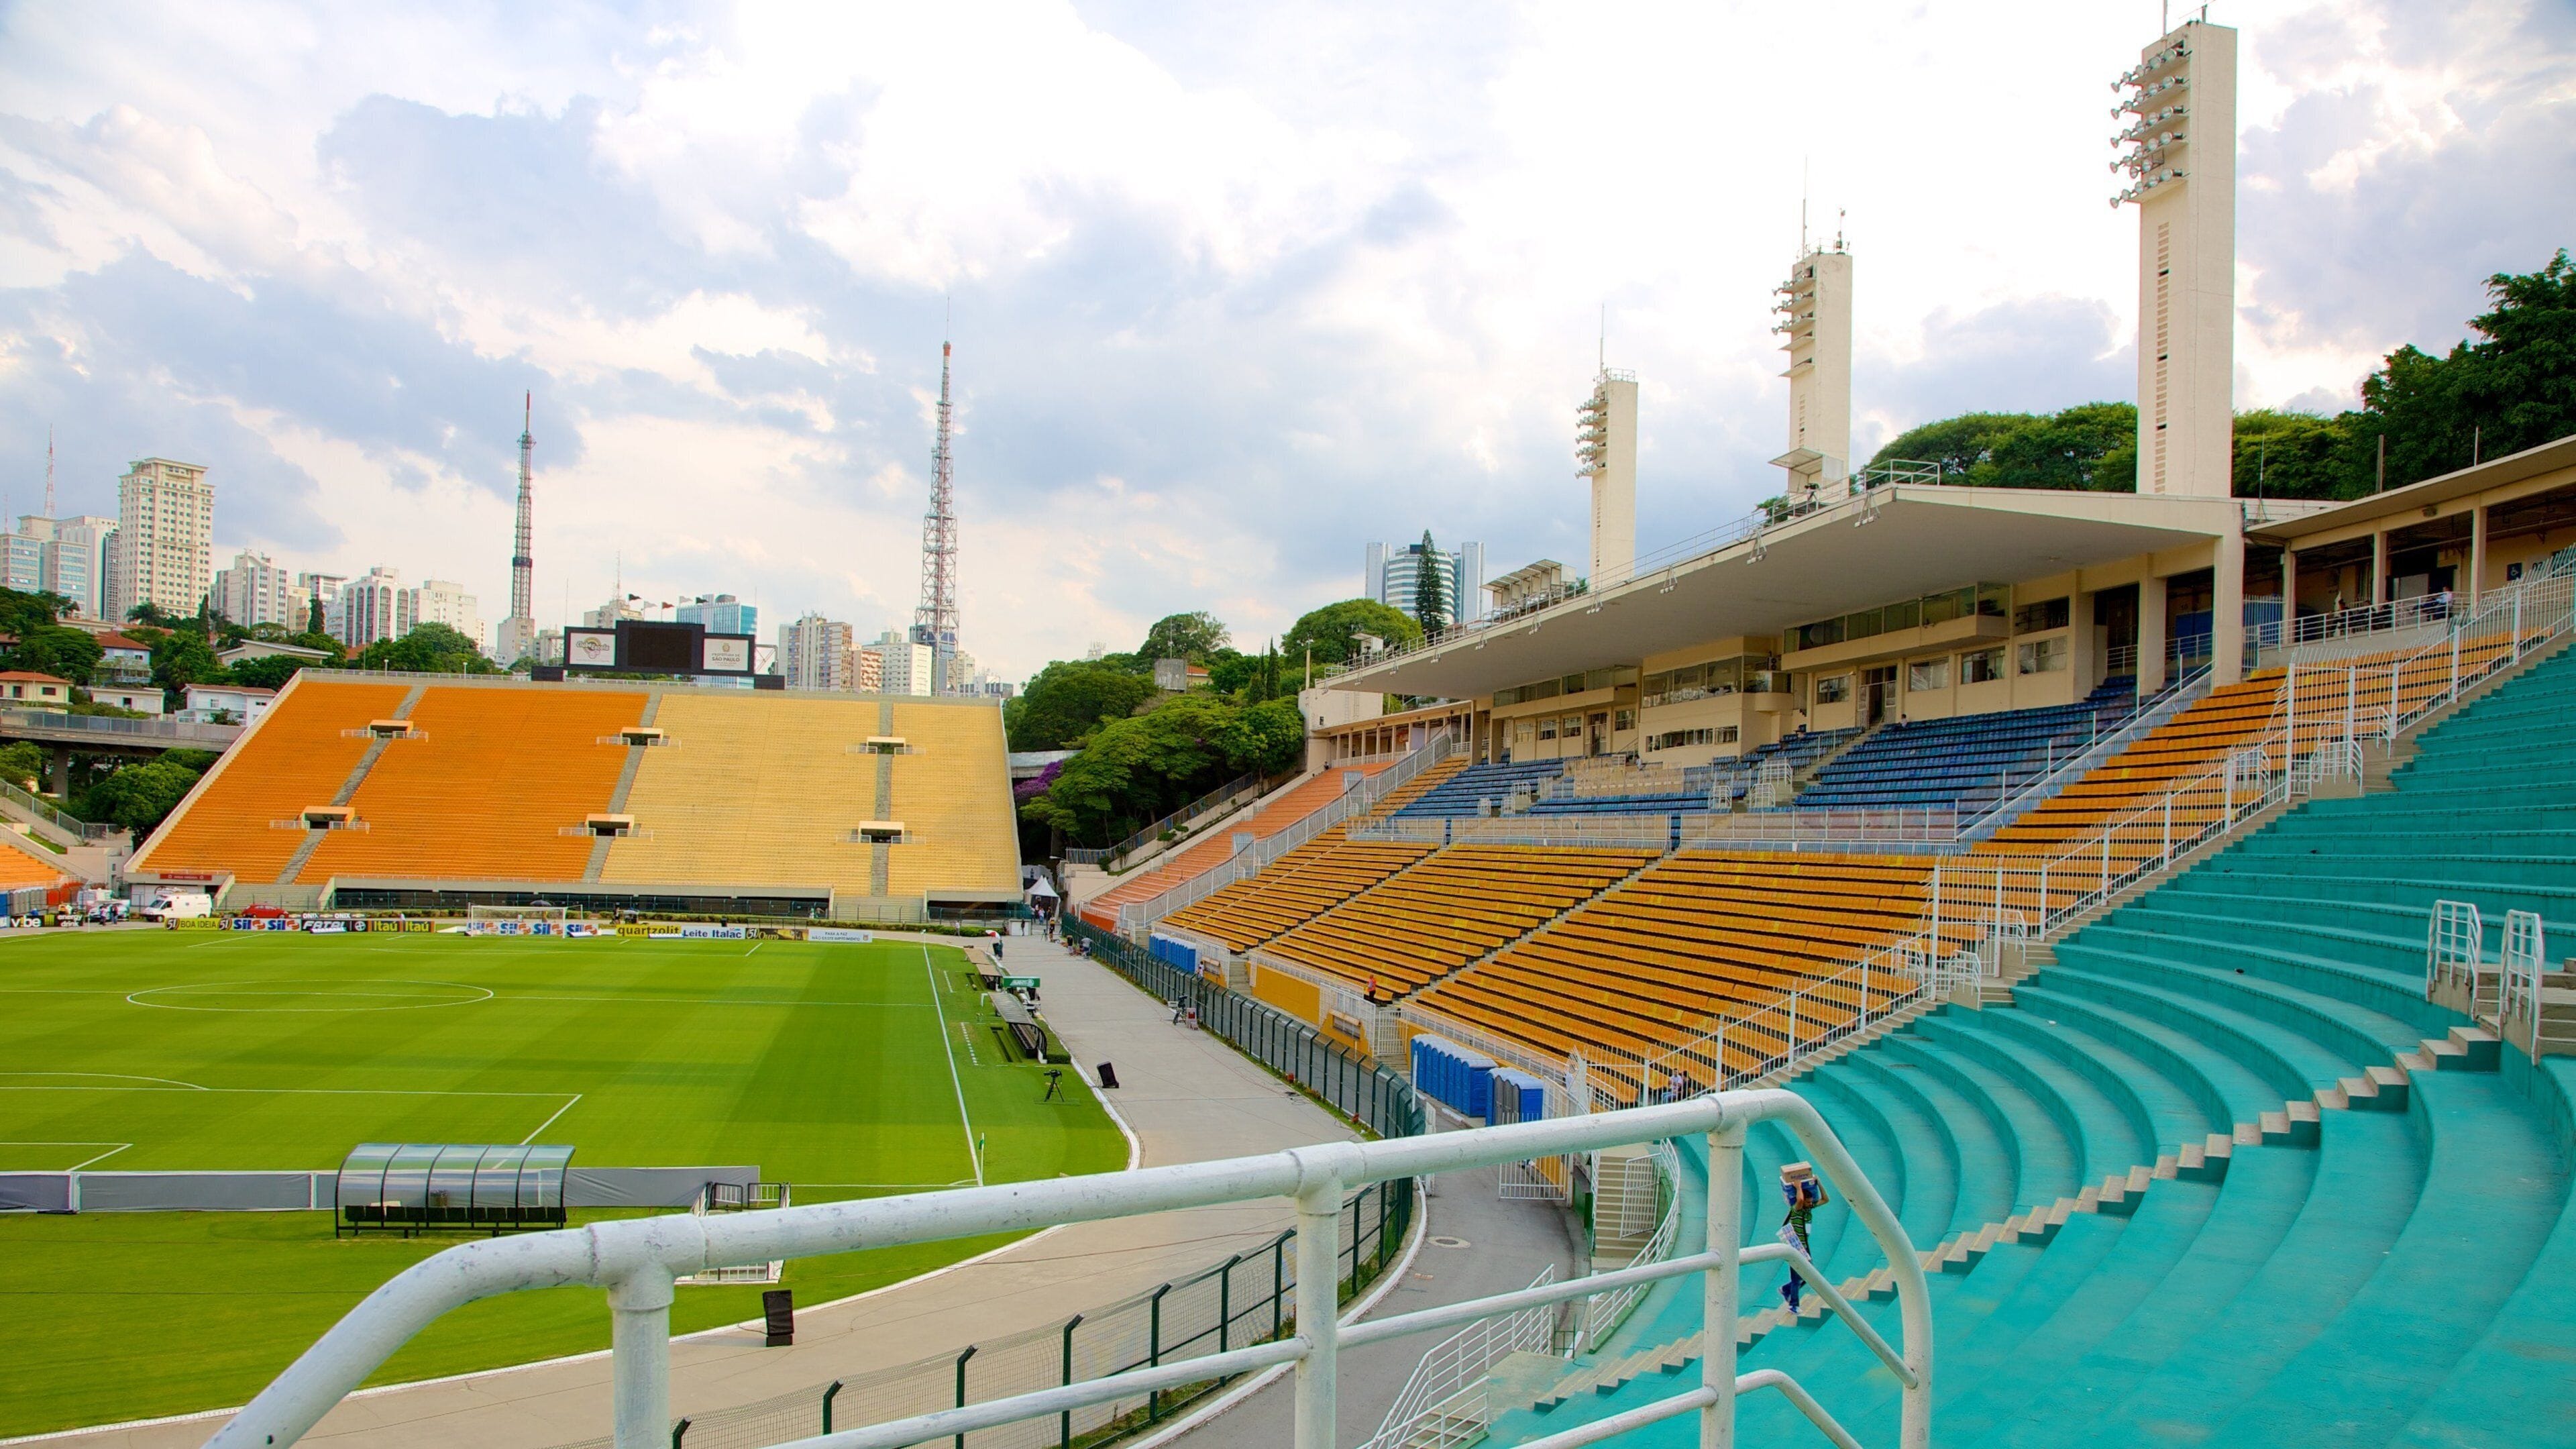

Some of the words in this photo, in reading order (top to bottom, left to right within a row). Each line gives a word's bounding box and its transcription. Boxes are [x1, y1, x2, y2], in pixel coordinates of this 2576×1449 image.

[166, 918, 176, 930] 51
[198, 920, 217, 928] IDEIA
[219, 918, 229, 930] 51
[233, 919, 252, 930] Sil
[268, 920, 286, 930] Sil
[374, 920, 398, 931] Itaú
[405, 920, 429, 932] Itaú
[500, 923, 518, 934] Sil
[534, 923, 551, 934] Sil
[617, 926, 680, 936] quartzolit
[683, 929, 708, 938] Leite
[712, 929, 742, 938] Italac
[759, 931, 779, 940] Ouro
